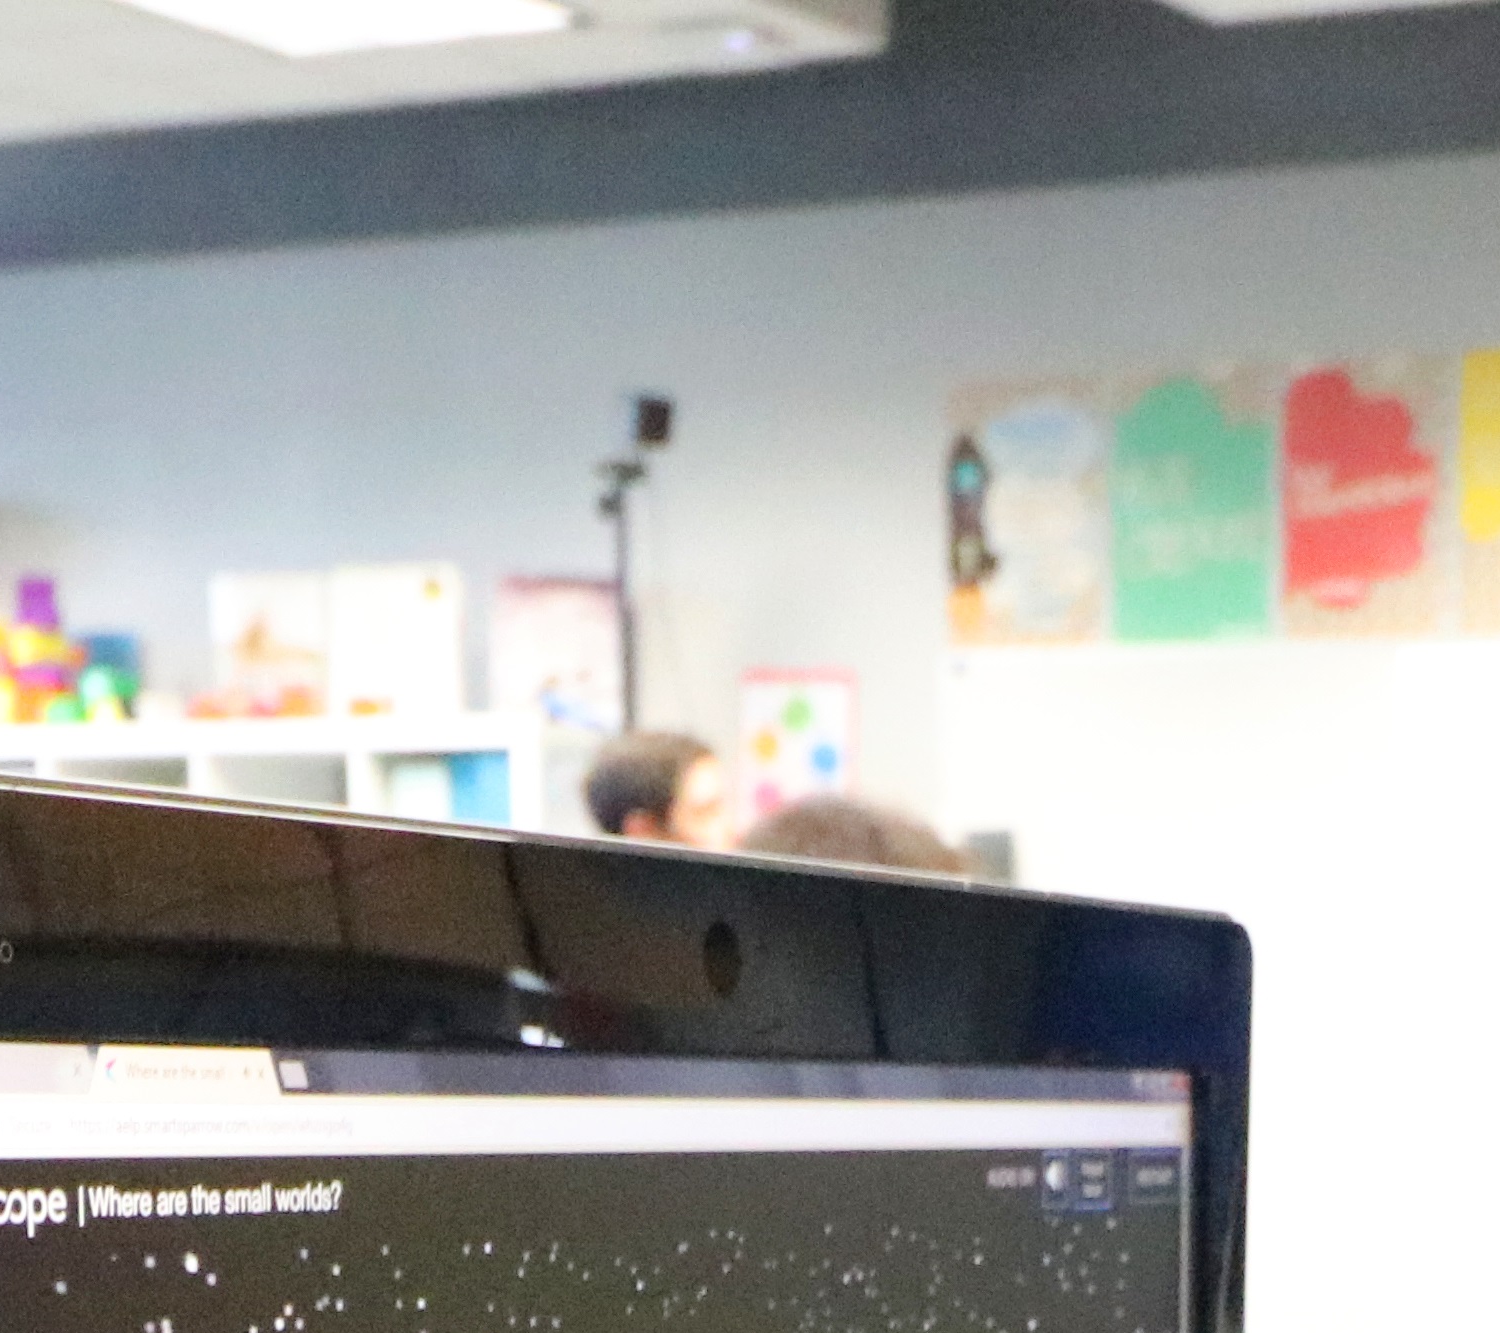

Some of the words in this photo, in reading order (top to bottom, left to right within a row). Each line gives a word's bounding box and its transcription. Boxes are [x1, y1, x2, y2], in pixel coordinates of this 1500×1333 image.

[88, 1183, 153, 1218] Where
[156, 1190, 189, 1216] are
[190, 1184, 221, 1214] the
[223, 1181, 273, 1215] small
[274, 1178, 343, 1213] worlds?
